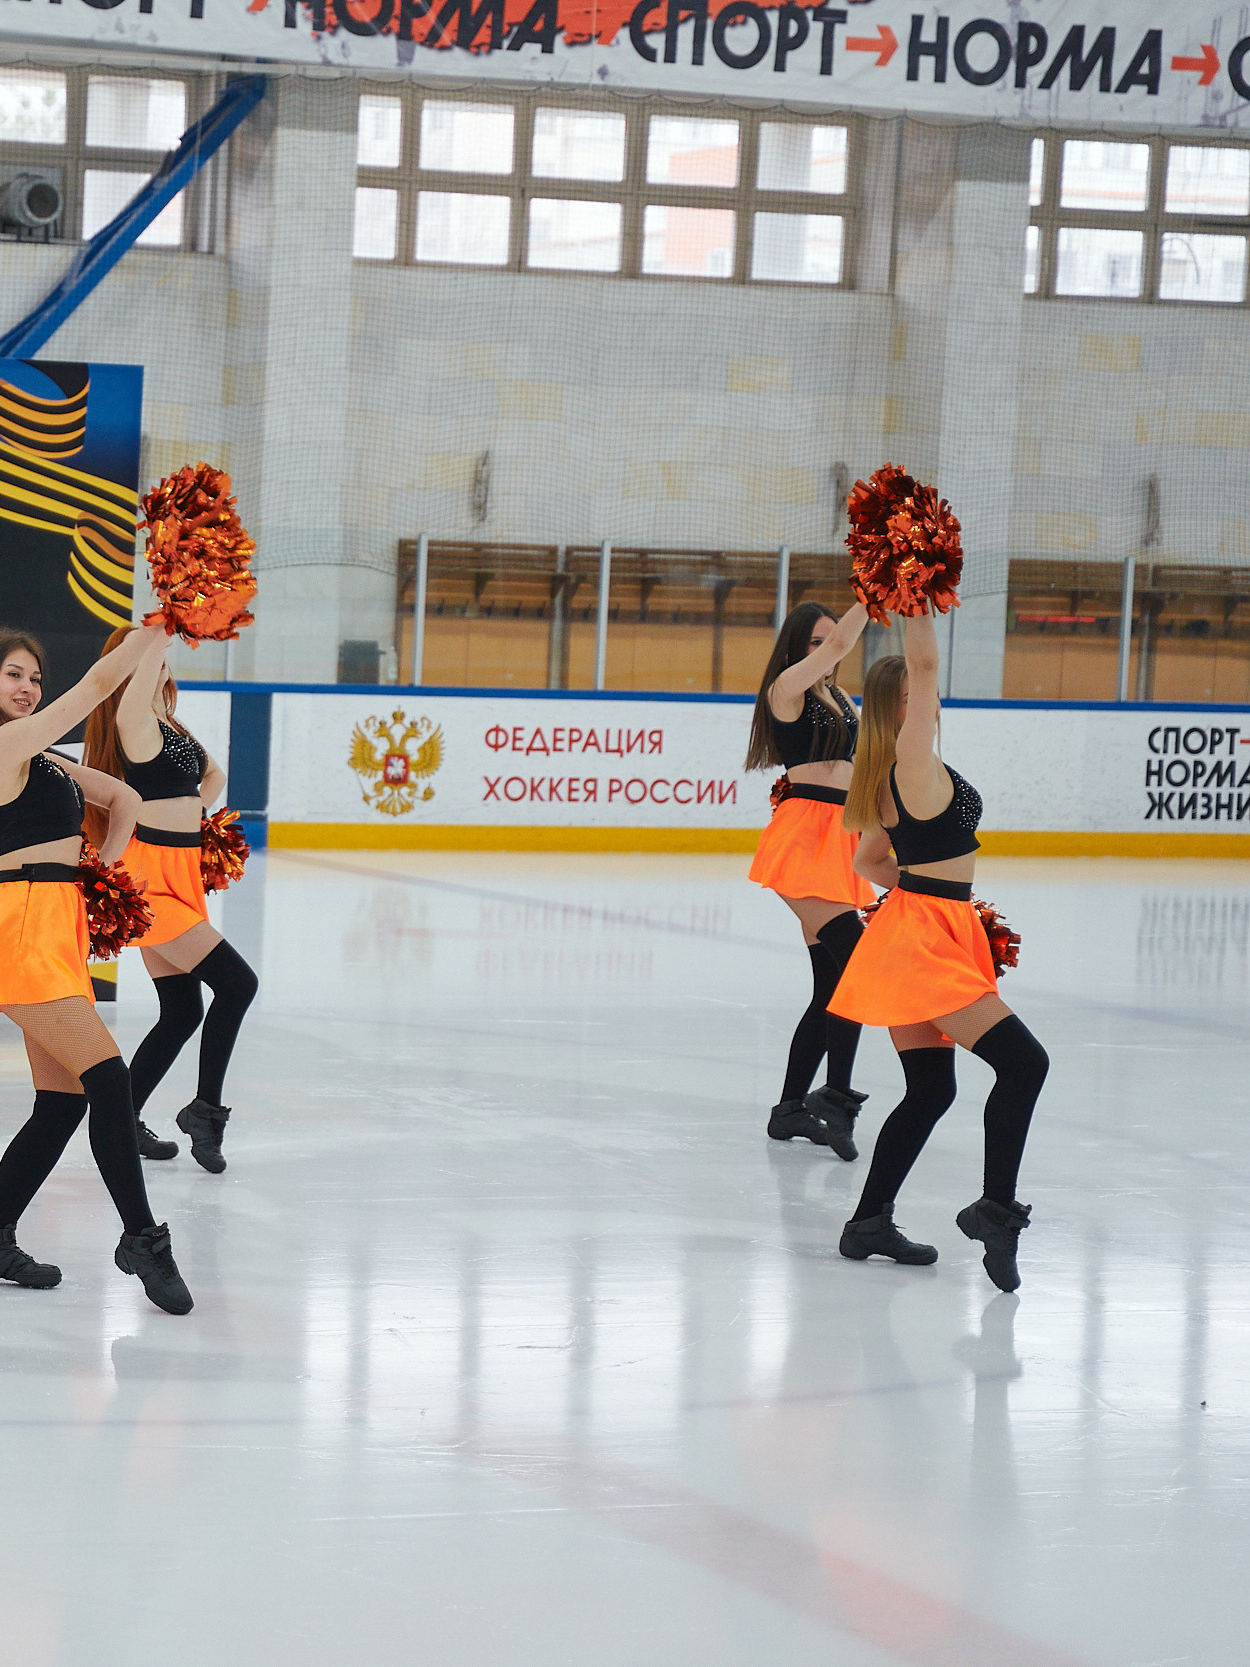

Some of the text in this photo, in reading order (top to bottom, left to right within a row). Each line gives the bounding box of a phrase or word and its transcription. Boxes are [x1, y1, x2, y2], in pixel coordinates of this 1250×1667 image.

[629, 0, 848, 76] СПОРТ
[906, 14, 1163, 96] НОРМА
[484, 723, 664, 758] ФЕДЕРАЦИЯ
[1147, 726, 1241, 755] СПОРТ
[483, 776, 738, 805] ХОККЕЯ РОССИИ
